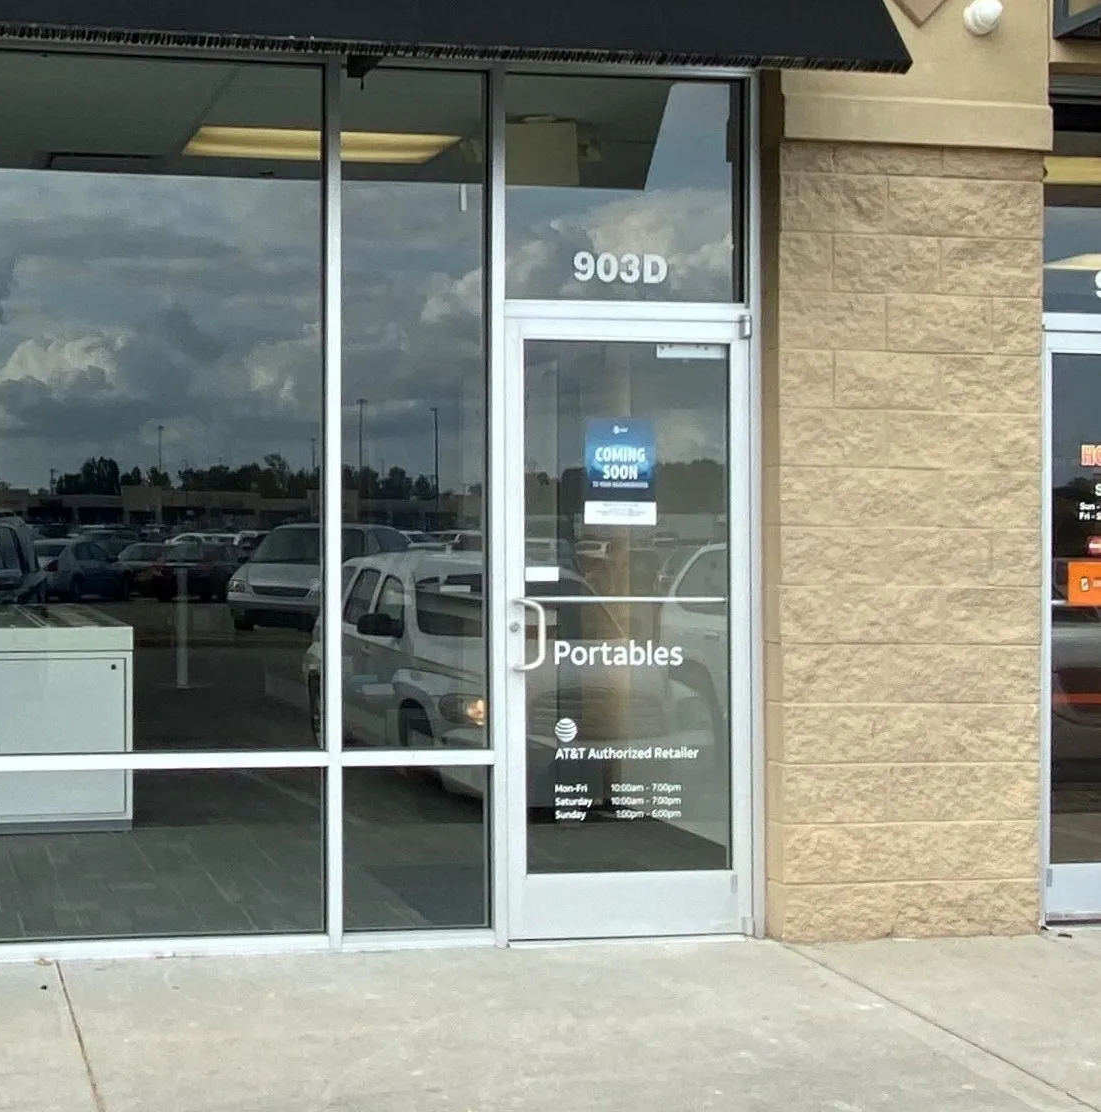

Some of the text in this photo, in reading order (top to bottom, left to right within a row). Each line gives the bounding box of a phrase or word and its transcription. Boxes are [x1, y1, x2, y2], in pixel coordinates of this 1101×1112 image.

[573, 251, 668, 283] 903D
[595, 447, 646, 462] COMING
[602, 464, 639, 480] SOON
[554, 640, 683, 665] Portables
[555, 746, 699, 759] AT&T Authorized Retailer
[555, 784, 588, 793] Mon-Fri
[611, 783, 644, 792] 10:00am
[651, 783, 682, 794] 7:00pm
[555, 797, 593, 808] Saturday
[611, 796, 644, 805] 10:00am
[651, 796, 682, 806] 7:00pm
[555, 810, 586, 821] Sunday
[651, 809, 682, 819] 6:00pm
